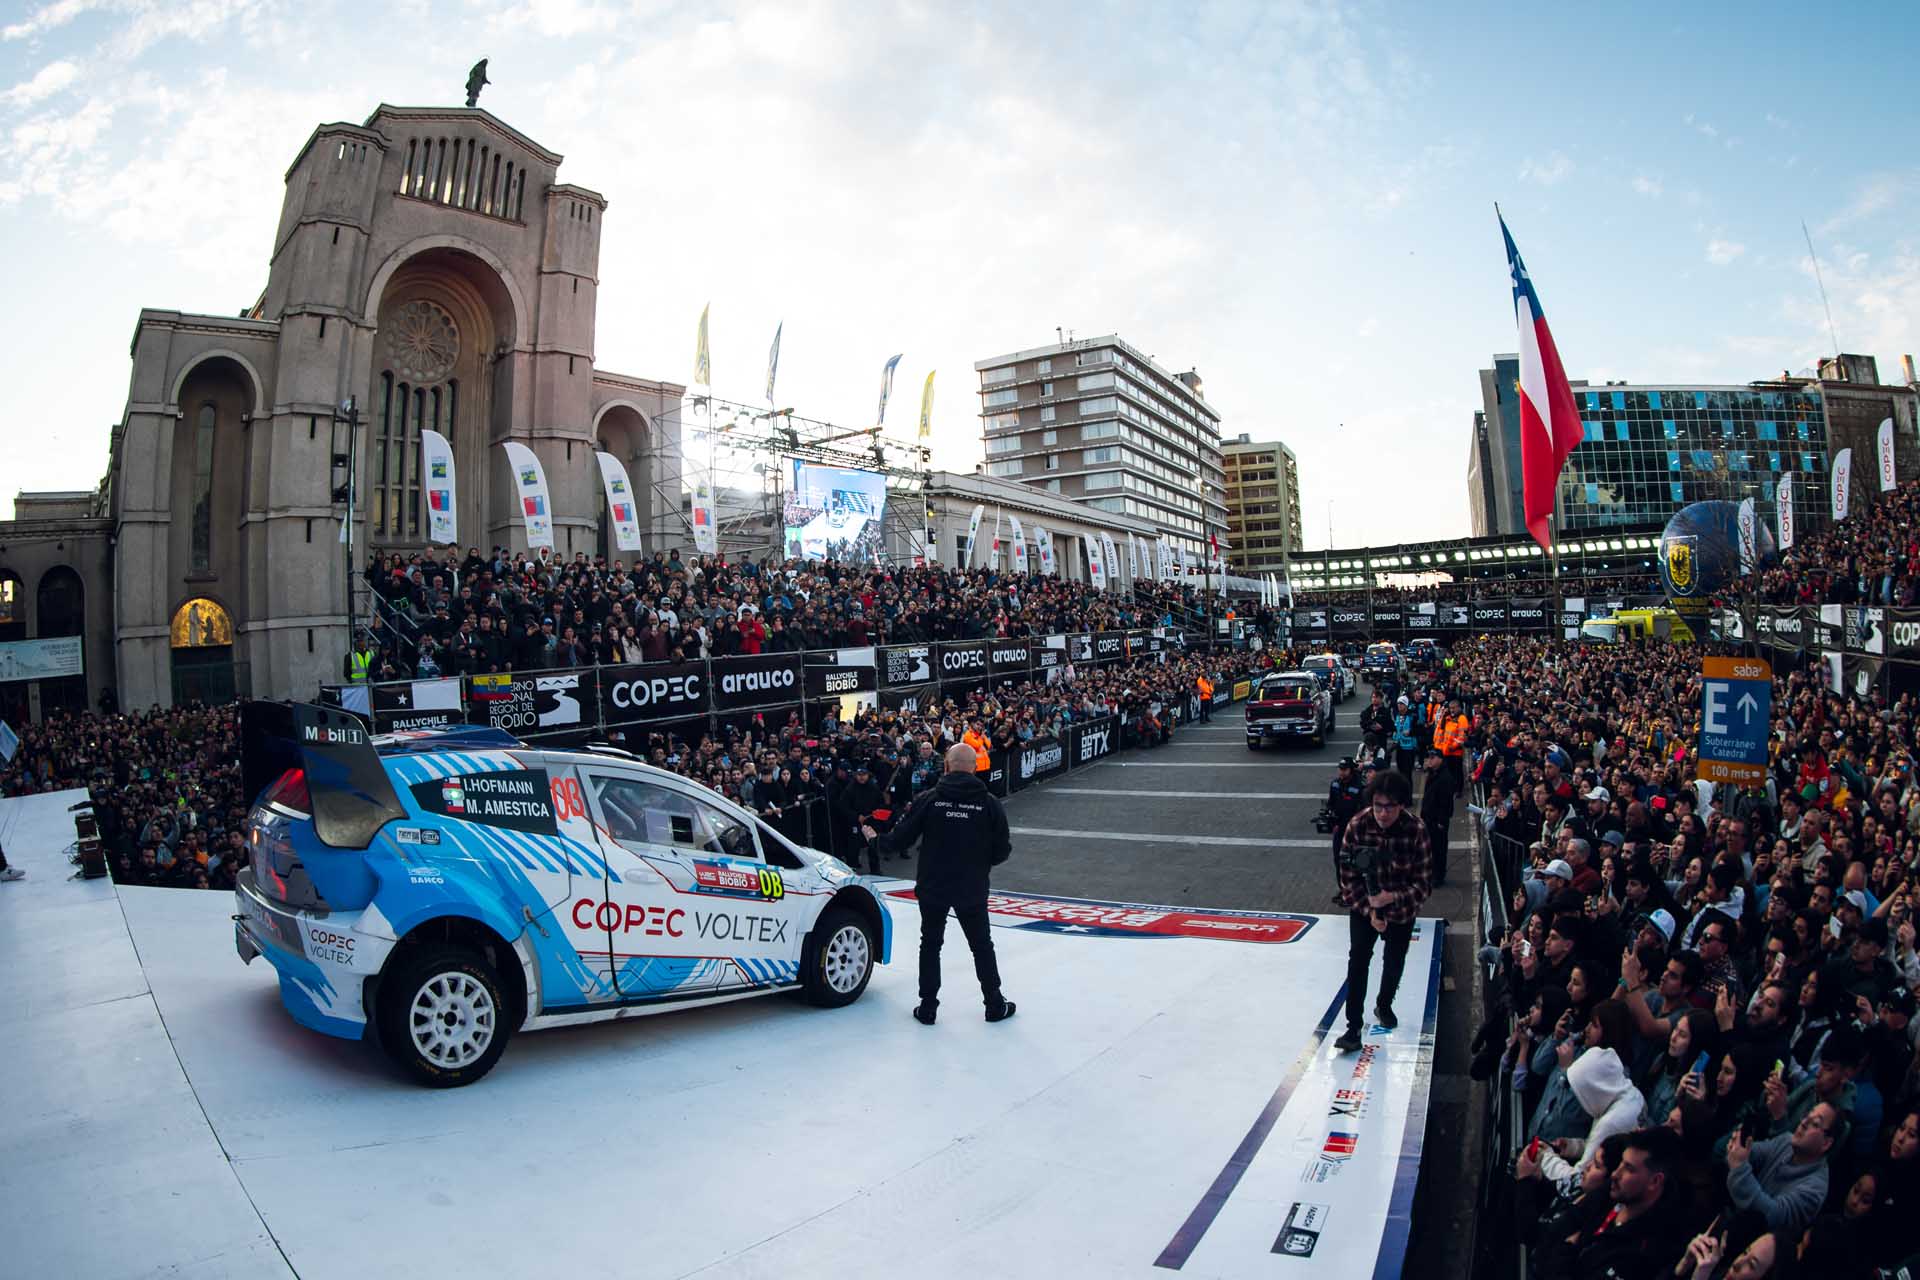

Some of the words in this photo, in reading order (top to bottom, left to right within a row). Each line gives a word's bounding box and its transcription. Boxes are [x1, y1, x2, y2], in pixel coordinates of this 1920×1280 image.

[1883, 437, 1891, 482] COPEC
[1836, 467, 1845, 511] COPEC
[1780, 488, 1790, 542] COPEC
[1333, 613, 1365, 623] COPEC
[1375, 613, 1400, 621] arauco
[1475, 609, 1505, 619] COPEC
[1512, 609, 1543, 617] arauco
[1098, 638, 1120, 653] COPEC
[943, 649, 984, 670] COPEC
[993, 648, 1027, 664] arauco
[825, 671, 858, 681] RALLYCHILE
[1733, 664, 1759, 677] saba
[722, 668, 794, 694] arauco
[612, 675, 700, 709] COPEC
[521, 701, 535, 711] DEL
[1704, 682, 1729, 734] E
[393, 715, 447, 729] RALLYCHILE
[305, 726, 346, 743] Mobil
[1711, 746, 1747, 759] Catedral
[1711, 764, 1728, 777] 100
[463, 779, 533, 795] I.HOFMANN
[467, 799, 482, 814] M.
[485, 800, 549, 817] AMESTICA
[946, 811, 969, 819] OFICIAL
[573, 898, 686, 938] COPEC
[695, 911, 788, 944] VOLTEX
[311, 929, 356, 951] COPEC
[310, 943, 353, 966] VOLTEX
